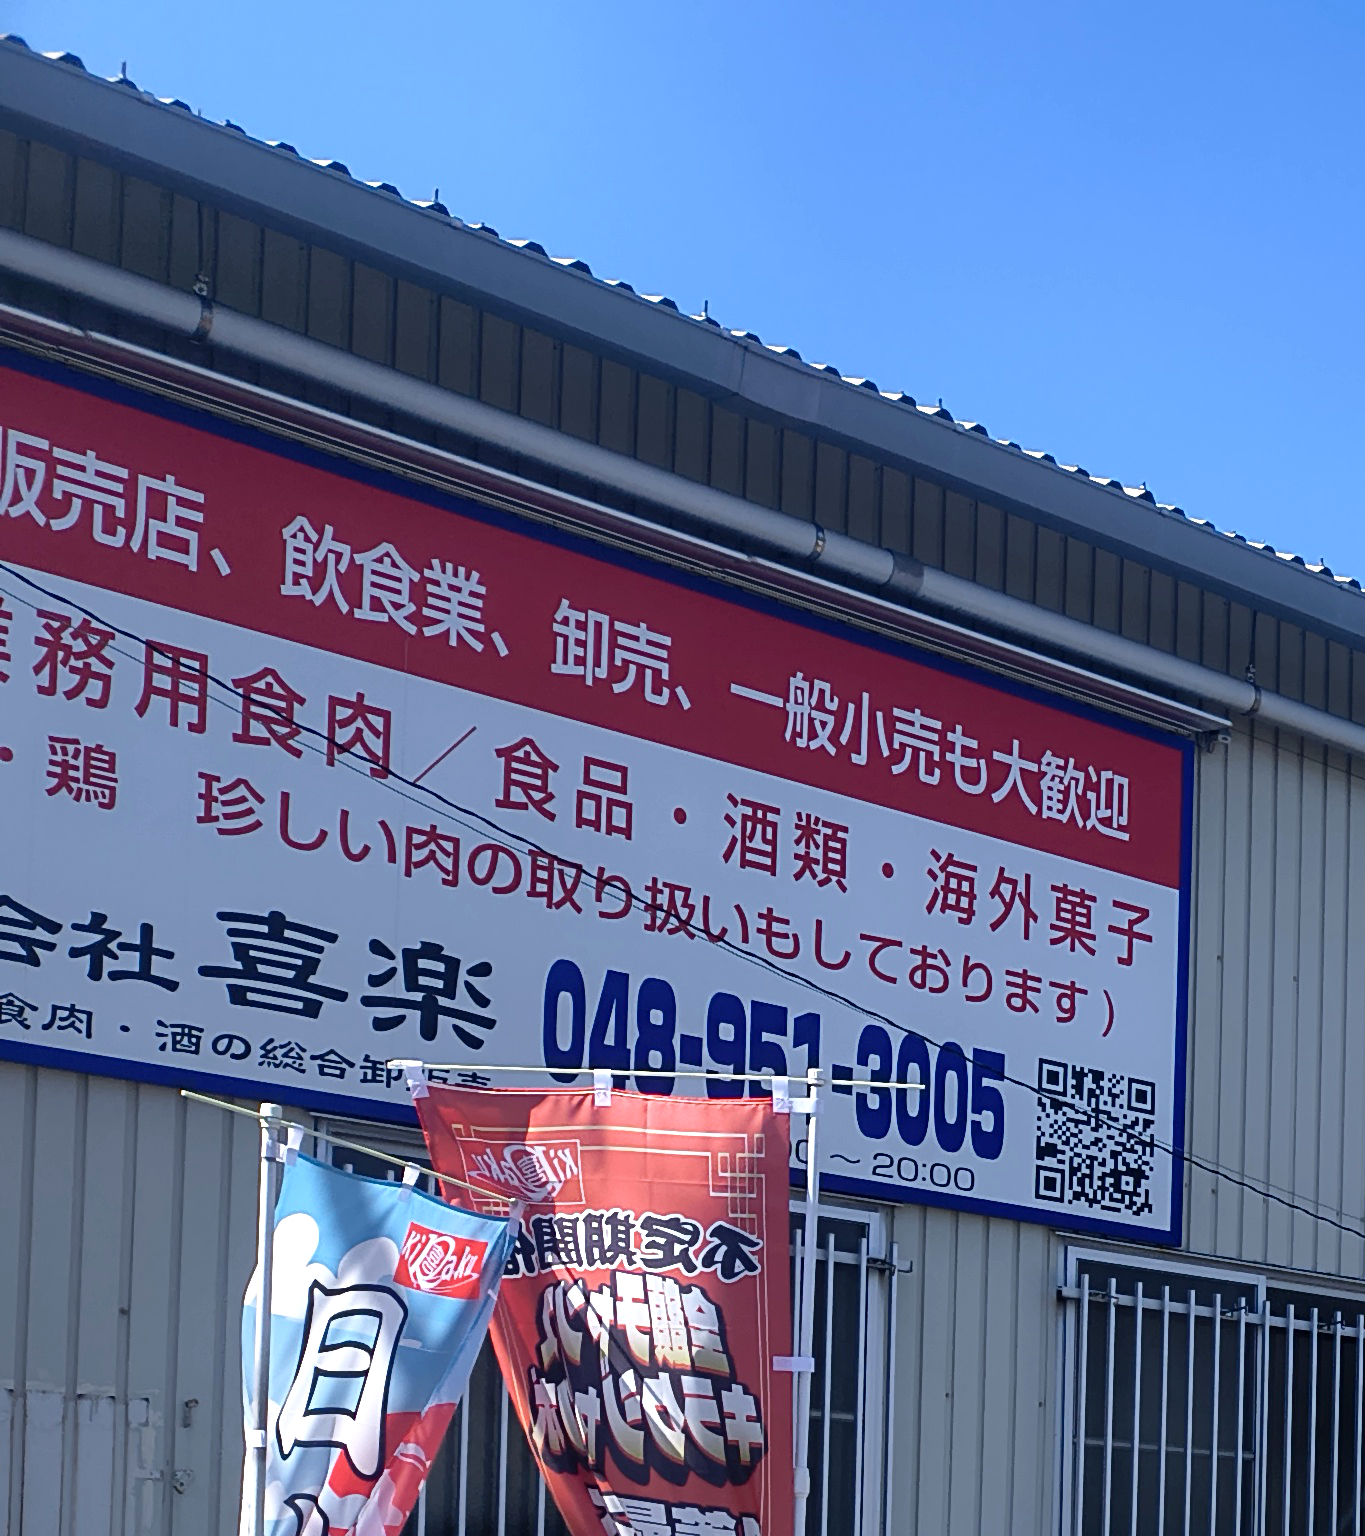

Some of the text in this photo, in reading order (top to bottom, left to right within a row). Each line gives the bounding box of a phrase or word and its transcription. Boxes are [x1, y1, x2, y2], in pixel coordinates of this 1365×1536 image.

[0, 597, 1154, 967] 務用食肉／食品・酒類・海外菓子
[543, 958, 1006, 1161] 048-951-3005
